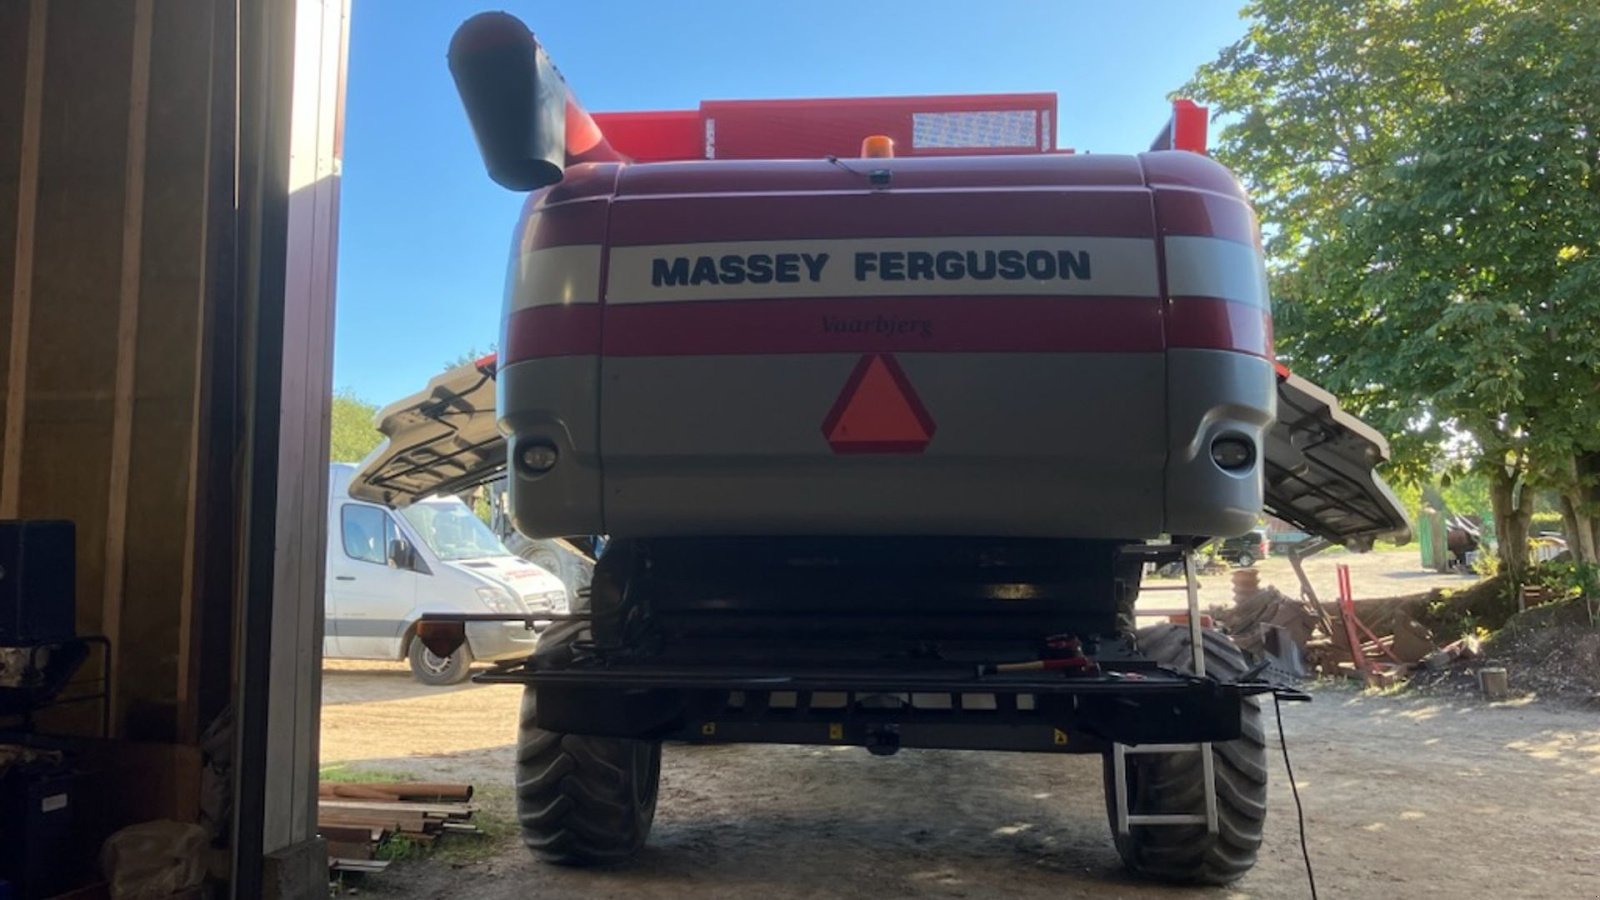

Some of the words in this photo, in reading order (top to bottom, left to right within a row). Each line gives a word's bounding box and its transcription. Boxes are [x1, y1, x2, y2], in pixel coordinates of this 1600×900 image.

[652, 253, 830, 287] MASSEY
[854, 250, 1091, 281] FERGUSON
[821, 313, 934, 338] Vaarbjerg
